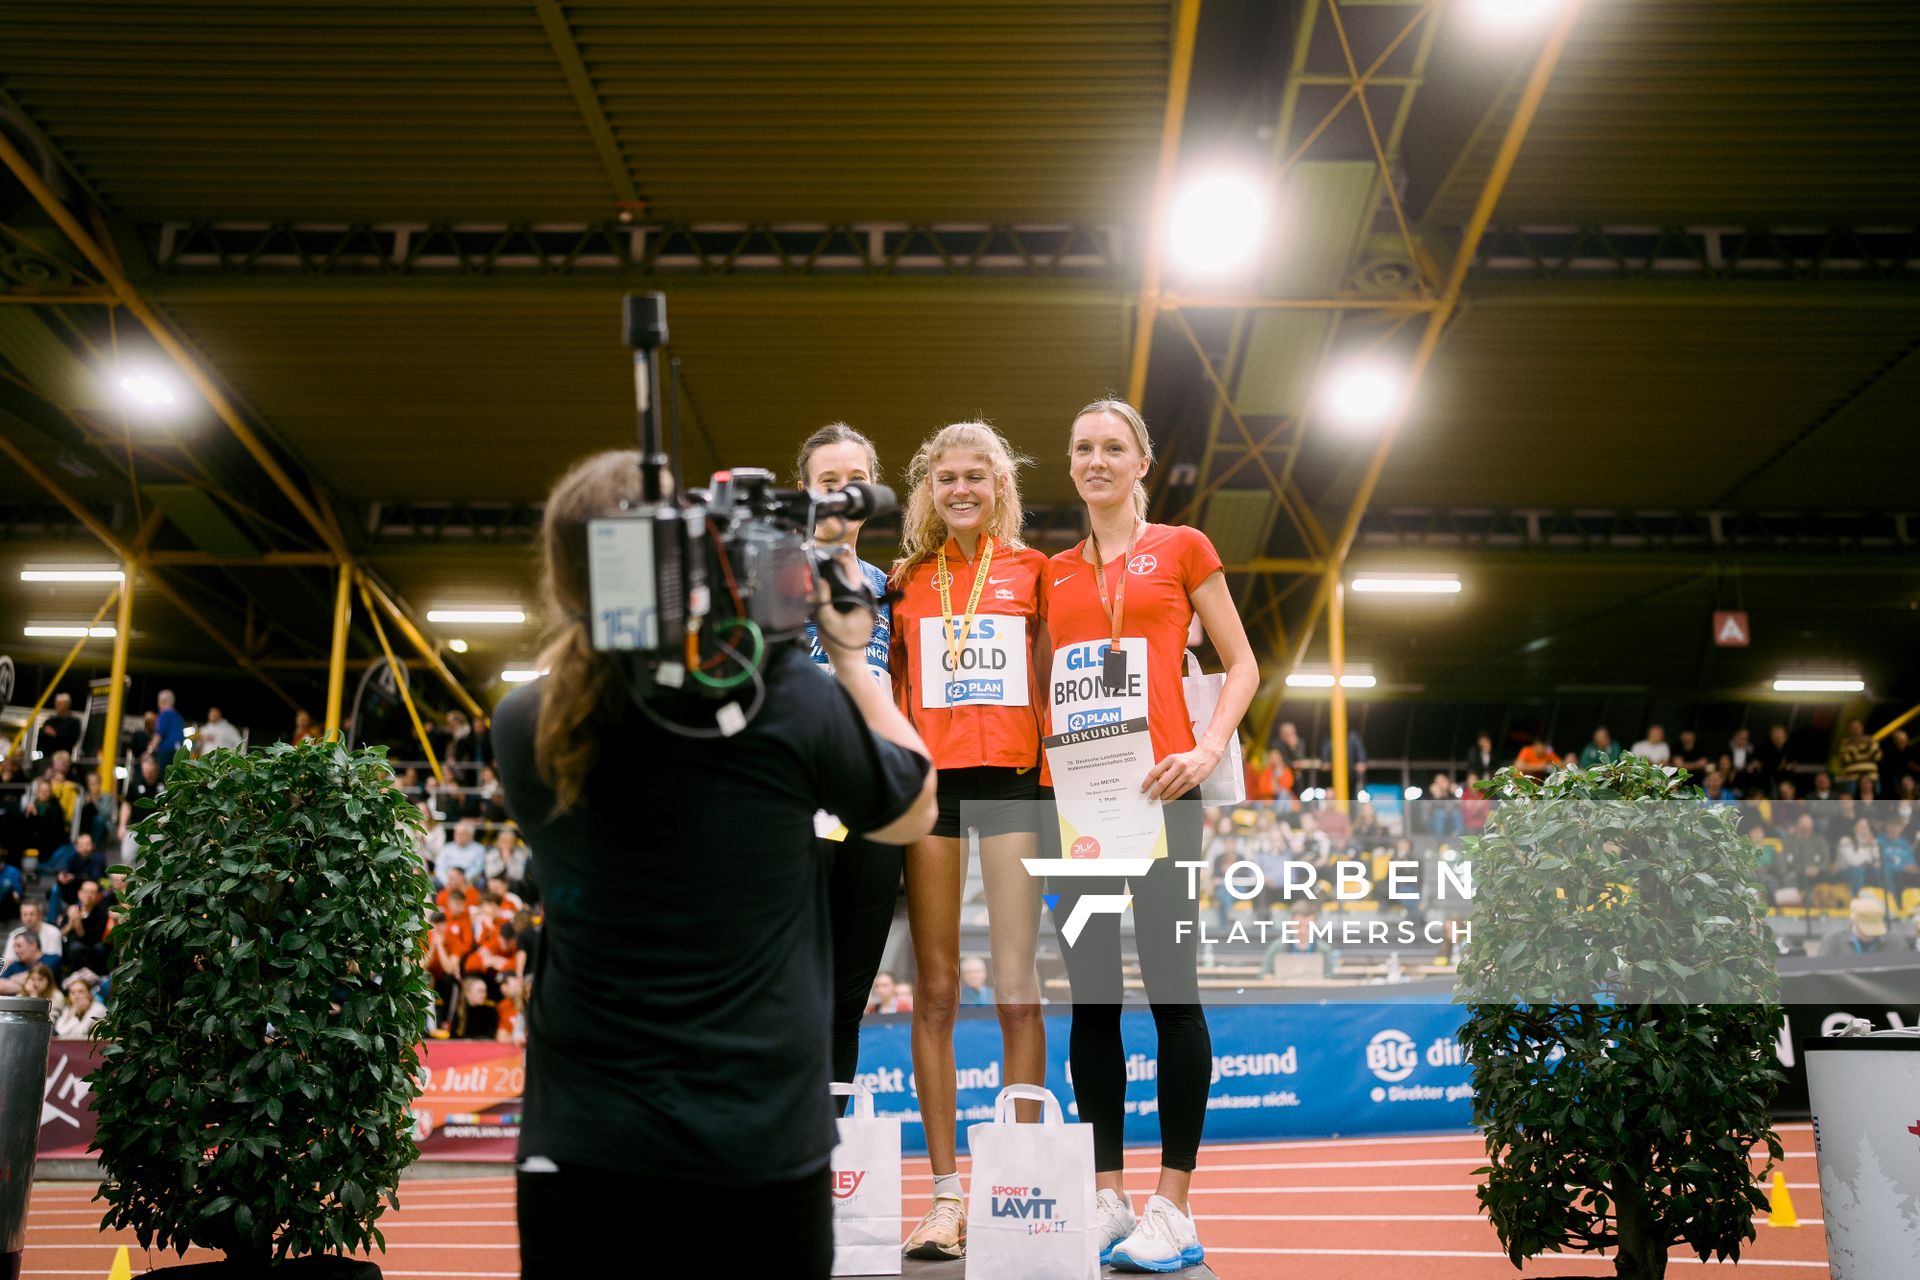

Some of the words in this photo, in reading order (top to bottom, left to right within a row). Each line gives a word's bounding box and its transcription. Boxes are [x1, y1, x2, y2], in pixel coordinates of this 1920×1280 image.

[1719, 616, 1745, 641] A
[941, 647, 1007, 672] GOLD
[969, 682, 1001, 693] PLAN
[1054, 673, 1142, 706] BRONZE
[1086, 711, 1120, 724] PLAN
[1060, 722, 1130, 745] URKUNDE
[1211, 1045, 1298, 1085] gesund
[1366, 1041, 1418, 1071] BIG
[441, 1066, 489, 1093] Juli
[493, 1066, 526, 1093] 20
[853, 1066, 905, 1094] rekt
[991, 1185, 1029, 1197] SPORT
